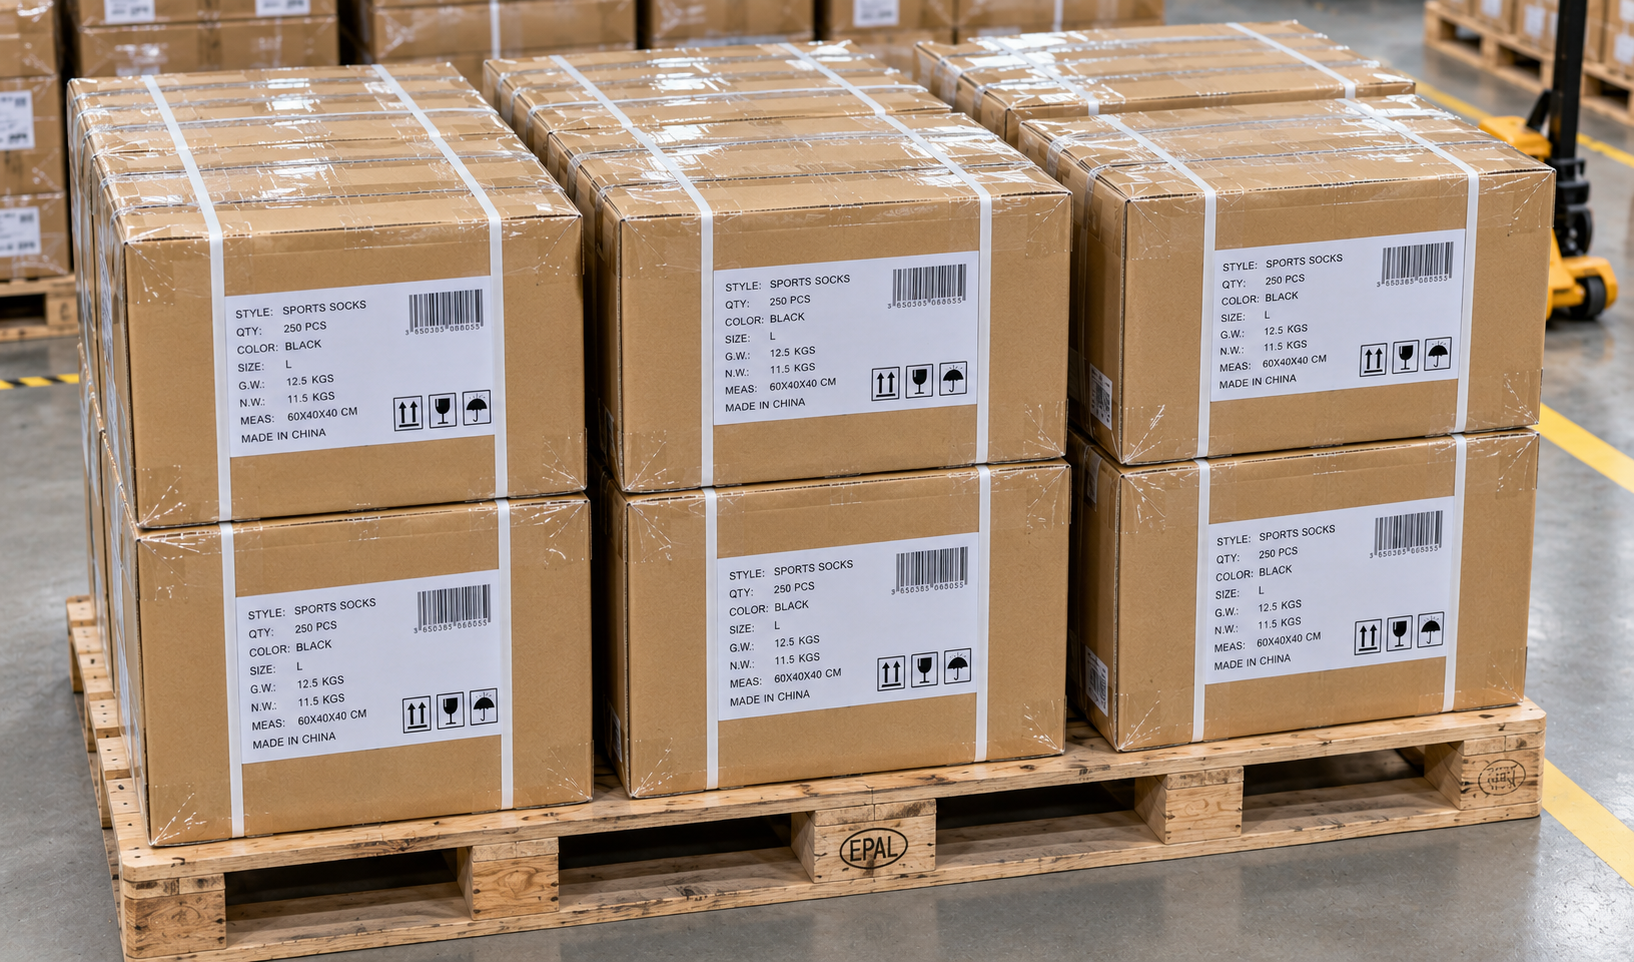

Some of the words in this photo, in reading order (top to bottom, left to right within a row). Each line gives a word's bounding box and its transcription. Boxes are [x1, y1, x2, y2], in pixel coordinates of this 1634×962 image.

[1222, 260, 1258, 272] STYLE:
[1266, 256, 1306, 268] SPORTS
[1308, 253, 1343, 265] SOCKS
[725, 281, 762, 292] STYLE:
[770, 277, 812, 289] SPORTS
[815, 274, 850, 286] SOCKS
[1222, 279, 1246, 290] QTY:
[1265, 276, 1282, 286] 250
[1285, 273, 1305, 284] PCS
[725, 299, 750, 310] QTY:
[770, 296, 788, 306] 250
[790, 294, 811, 304] PCS
[1221, 294, 1260, 306] COLOR:
[1265, 291, 1298, 302] BLACK
[236, 307, 273, 319] STYLE:
[282, 303, 326, 316] SPORTS
[329, 300, 367, 312] SOCKS
[1220, 312, 1246, 323] SIZE:
[1264, 310, 1270, 320] L
[236, 326, 262, 337] QTY:
[284, 323, 302, 333] 250
[305, 320, 327, 331] PCS
[724, 316, 764, 327] COLOR:
[770, 312, 805, 324] BLACK
[725, 333, 750, 344] SIZE:
[770, 332, 776, 340] L
[1220, 329, 1244, 340] G.W.:
[1264, 326, 1284, 336] 12.5
[1287, 323, 1308, 334] KGS
[236, 343, 278, 355] COLOR:
[285, 339, 322, 351] BLACK
[725, 351, 750, 361] G.W.:
[770, 348, 790, 358] 12.5
[794, 346, 816, 356] KGS
[1220, 346, 1244, 356] N.W.:
[1264, 342, 1283, 352] 11.5
[1286, 339, 1308, 350] KGS
[238, 362, 264, 372] SIZE:
[285, 360, 292, 369] L
[725, 368, 749, 378] N.W.:
[770, 364, 790, 374] 11.5
[794, 362, 816, 372] KGS
[1220, 361, 1251, 372] MEAS:
[1262, 356, 1308, 368] 60X40X40
[1311, 354, 1327, 364] CM
[238, 380, 265, 390] G.W.:
[287, 376, 308, 386] 12.5
[312, 374, 334, 384] KGS
[725, 384, 757, 395] MEAS:
[769, 379, 818, 392] 60X40X40
[820, 377, 836, 387] CM
[1219, 378, 1249, 389] MADE
[1252, 377, 1262, 386] IN
[1265, 374, 1297, 385] CHINA
[240, 397, 265, 408] N.W.:
[288, 393, 308, 404] 11.5
[312, 391, 336, 402] KGS
[725, 401, 756, 412] MADE
[759, 400, 770, 410] IN
[772, 397, 806, 408] CHINA
[240, 414, 275, 425] MEAS:
[287, 408, 338, 422] 60X40X40
[340, 406, 358, 416] CM
[241, 432, 274, 444] MADE
[277, 431, 288, 440] IN
[291, 428, 326, 440] CHINA
[1216, 534, 1251, 546] STYLE:
[1259, 528, 1299, 542] SPORTS
[1302, 524, 1336, 537] SOCKS
[1216, 553, 1240, 564] QTY:
[1258, 549, 1276, 559] 250
[1278, 546, 1298, 557] PCS
[729, 568, 765, 581] STYLE:
[774, 563, 816, 576] SPORTS
[818, 559, 854, 572] SOCKS
[1215, 569, 1254, 582] COLOR:
[1259, 564, 1292, 577] BLACK
[729, 588, 754, 599] QTY:
[774, 584, 792, 594] 250
[794, 581, 815, 592] PCS
[1215, 588, 1240, 600] SIZE:
[1258, 586, 1264, 595] L
[248, 608, 286, 620] STYLE:
[294, 602, 337, 616] SPORTS
[340, 598, 376, 610] SOCKS
[729, 604, 769, 617] COLOR:
[774, 600, 809, 612] BLACK
[1214, 607, 1239, 618] G.W.:
[1258, 602, 1278, 612] 12.5
[1281, 599, 1302, 610] KGS
[248, 627, 274, 639] QTY:
[295, 623, 313, 634] 250
[316, 620, 338, 632] PCS
[729, 623, 754, 635] SIZE:
[774, 620, 780, 630] L
[1214, 624, 1238, 635] N.W.:
[1258, 619, 1278, 629] 11.5
[1280, 616, 1302, 627] KGS
[249, 644, 290, 658] COLOR:
[296, 639, 332, 652] BLACK
[729, 642, 754, 653] G.W.:
[775, 637, 795, 648] 12.5
[798, 634, 820, 645] KGS
[1214, 641, 1246, 653] MEAS:
[1256, 634, 1303, 648] 60X40X40
[1305, 631, 1321, 642] CM
[250, 664, 276, 676] SIZE:
[296, 662, 303, 671] L
[730, 660, 754, 670] N.W.:
[775, 654, 795, 665] 11.5
[798, 652, 820, 663] KGS
[1214, 659, 1243, 671] MADE
[1246, 658, 1256, 667] IN
[1259, 653, 1292, 666] CHINA
[250, 683, 276, 694] G.W.:
[298, 678, 318, 689] 12.5
[322, 675, 344, 686] KGS
[730, 676, 762, 688] MEAS:
[774, 670, 822, 684] 60X40X40
[825, 668, 842, 678] CM
[251, 701, 277, 712] N.W.:
[298, 696, 319, 707] 11.5
[322, 693, 345, 704] KGS
[730, 694, 760, 707] MADE
[764, 693, 774, 703] IN
[777, 689, 810, 702] CHINA
[252, 718, 285, 731] MEAS:
[298, 711, 347, 726] 60X40X40
[350, 708, 367, 720] CM
[252, 737, 284, 750] MADE
[288, 736, 299, 746] IN
[302, 731, 336, 744] CHINA
[850, 836, 898, 862] EPAL
